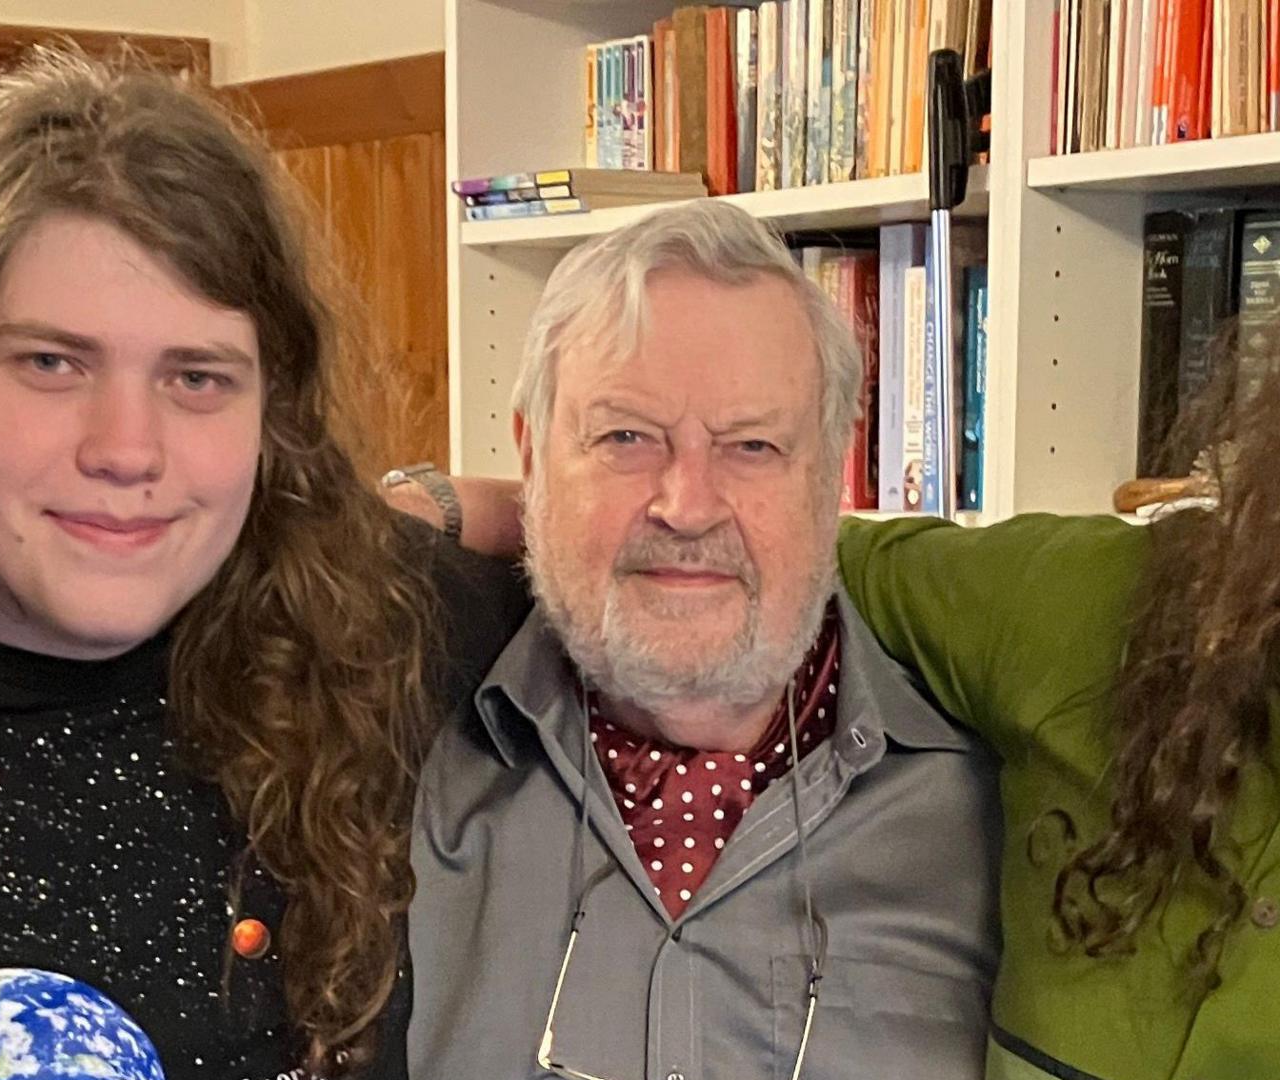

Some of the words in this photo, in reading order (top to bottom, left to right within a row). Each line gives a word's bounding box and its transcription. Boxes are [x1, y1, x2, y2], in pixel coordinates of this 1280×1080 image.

[926, 321, 935, 382] CHANGE
[925, 389, 935, 416] THE
[924, 421, 933, 477] WORLD
